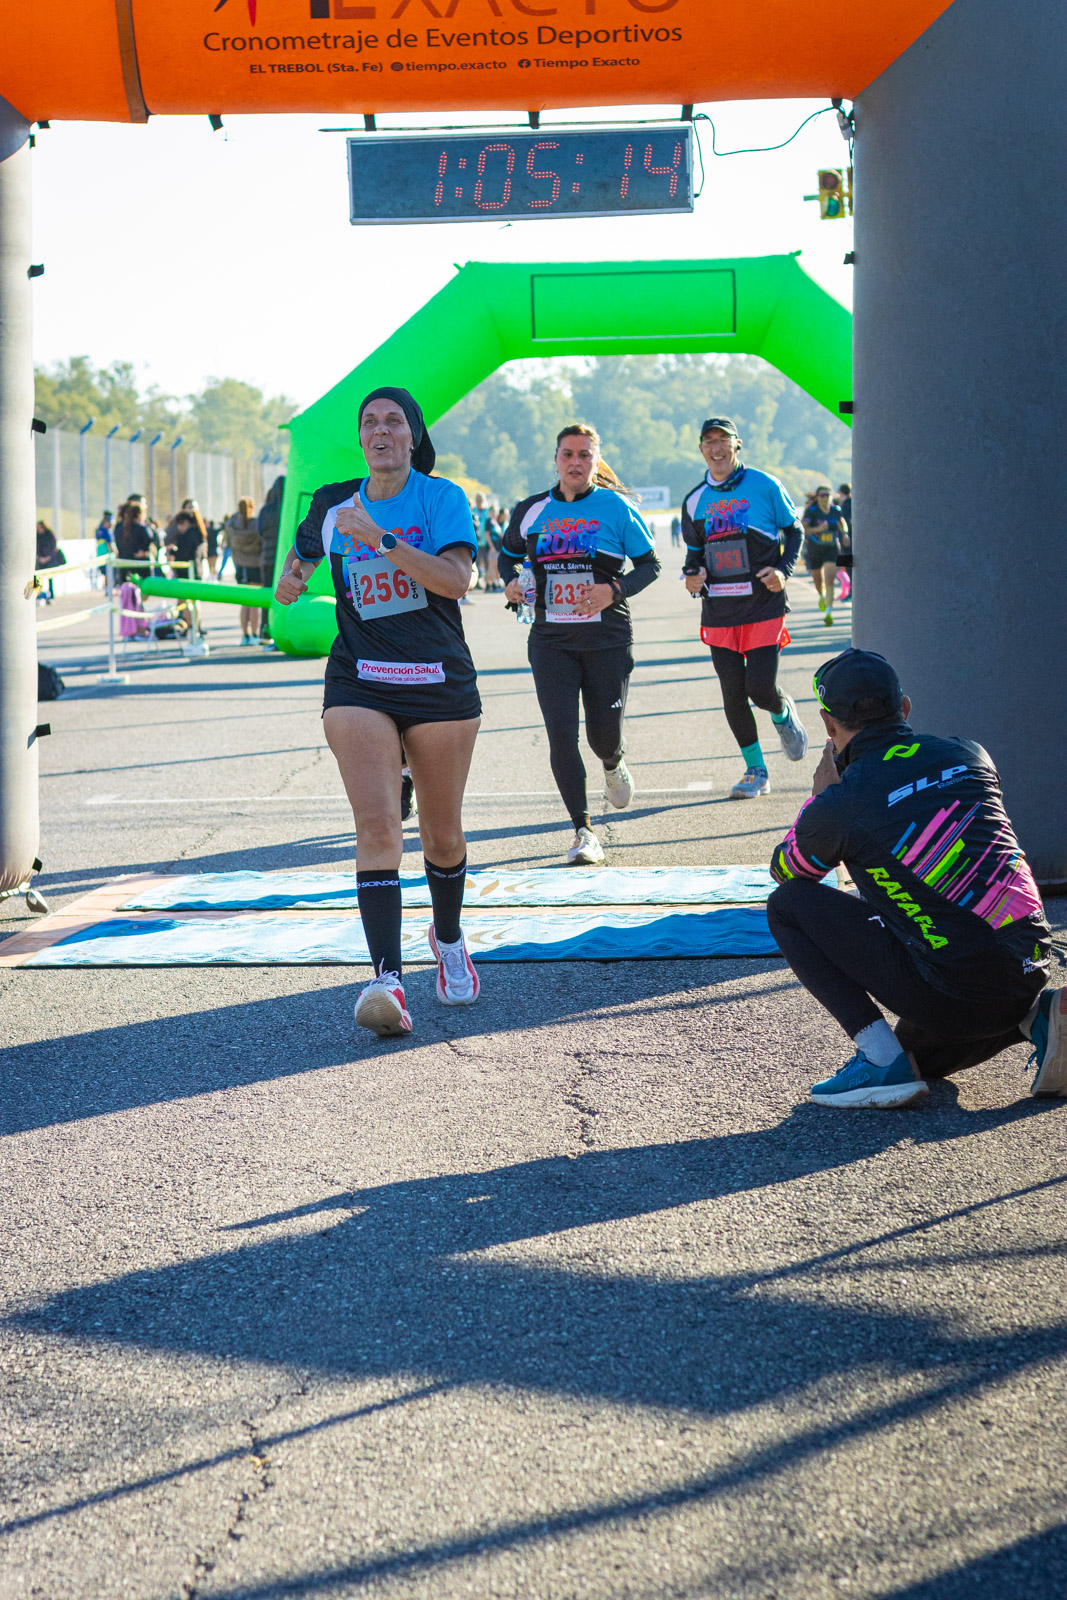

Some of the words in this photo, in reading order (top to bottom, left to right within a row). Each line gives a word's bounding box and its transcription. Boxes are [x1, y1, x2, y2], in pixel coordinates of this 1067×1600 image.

[203, 30, 379, 54] Cronometraje
[386, 28, 418, 48] de
[426, 28, 529, 48] Eventos
[537, 24, 683, 48] Deportivos
[250, 64, 266, 74] EL
[268, 63, 324, 74] TREBOL
[327, 62, 359, 75] (Sta.
[362, 62, 384, 73] Fe)
[406, 60, 507, 72] tiempo.exacto
[533, 58, 588, 69] Tiempo
[592, 57, 640, 67] Exacto
[714, 549, 742, 570] 363
[360, 569, 410, 606] 256
[361, 662, 414, 675] Prevención
[414, 664, 441, 675] Salud
[887, 764, 969, 808] SLP
